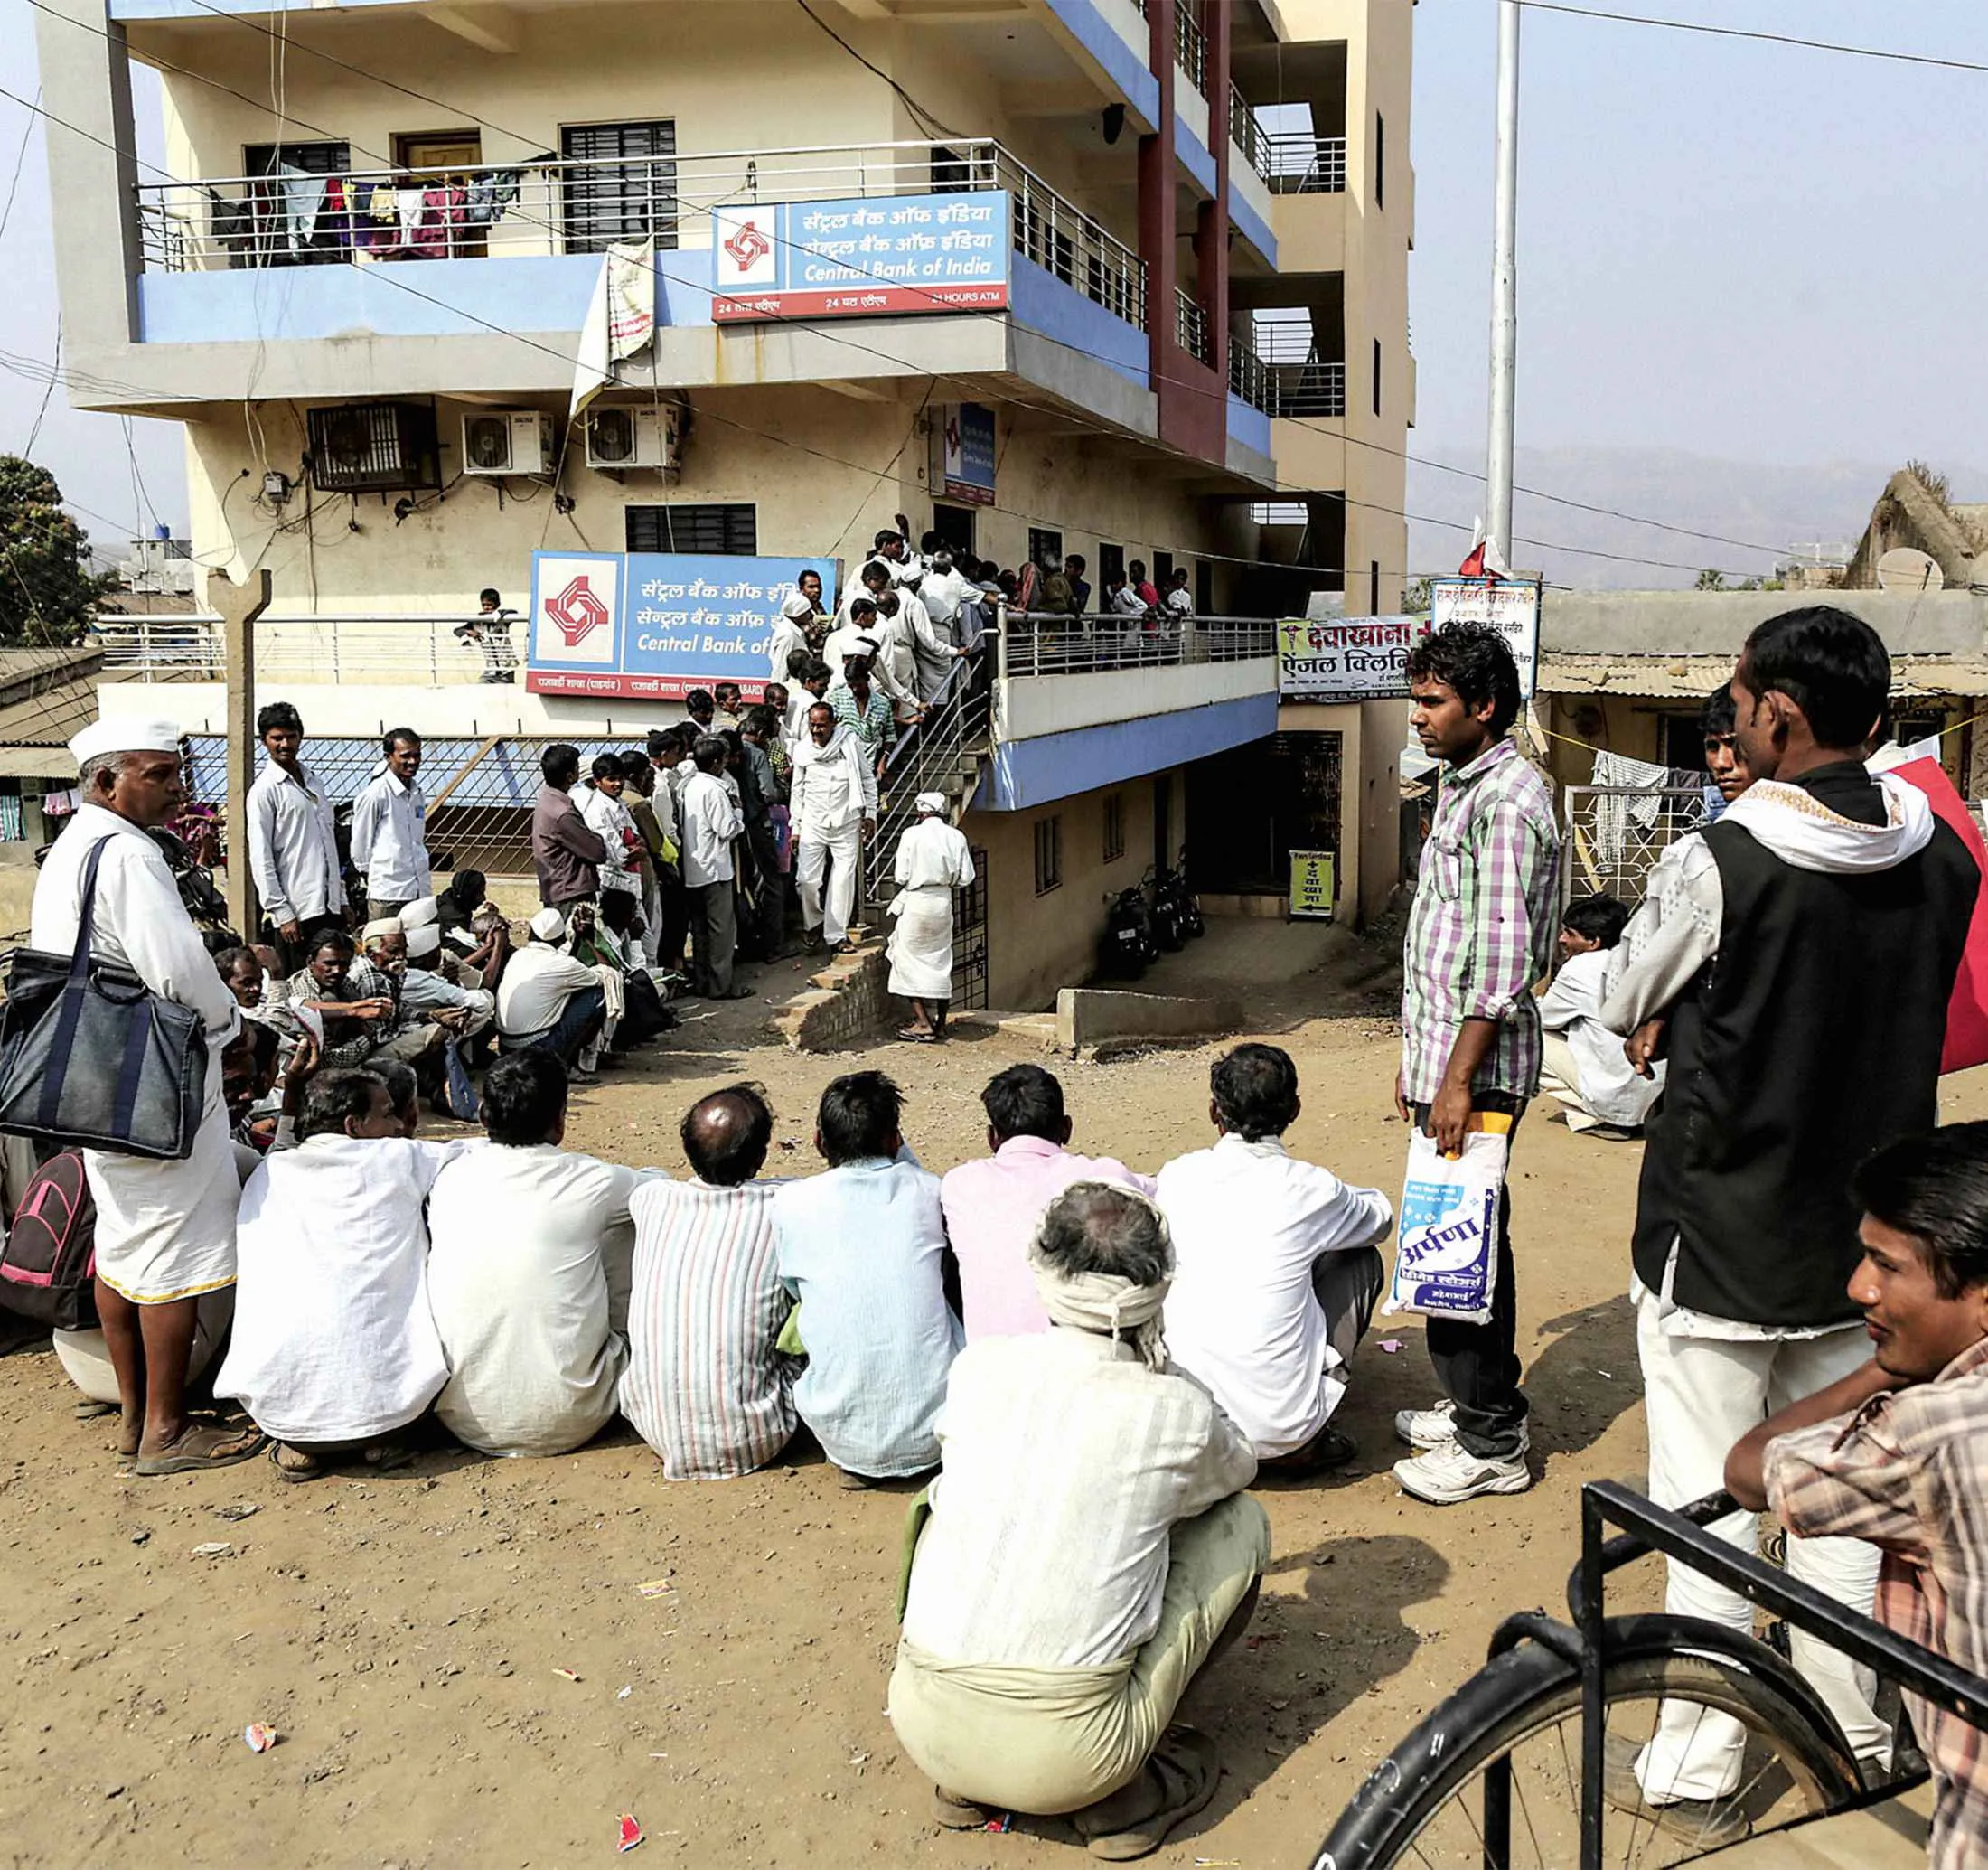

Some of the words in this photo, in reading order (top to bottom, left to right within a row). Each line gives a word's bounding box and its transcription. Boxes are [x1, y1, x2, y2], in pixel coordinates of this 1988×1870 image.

[802, 209, 849, 234] सेंट्रल
[889, 206, 932, 225] ऑफ
[936, 202, 993, 225] इंडिया
[804, 259, 867, 282] Central
[873, 258, 918, 278] Bank
[922, 257, 942, 276] of
[945, 256, 992, 275] India
[718, 304, 731, 315] 24
[825, 298, 839, 310] 24
[944, 293, 978, 303] HOURS
[980, 292, 1000, 301] ATM
[642, 579, 686, 603] सेंट्रल
[723, 582, 764, 600] ऑफ
[636, 606, 689, 630] सेन्ट्रल
[690, 606, 724, 625] बैंक
[637, 634, 699, 653] Central
[701, 635, 746, 653] Bank
[750, 635, 772, 654] of
[1308, 624, 1411, 652] दवाखाना
[1281, 652, 1337, 678] ऐंजल
